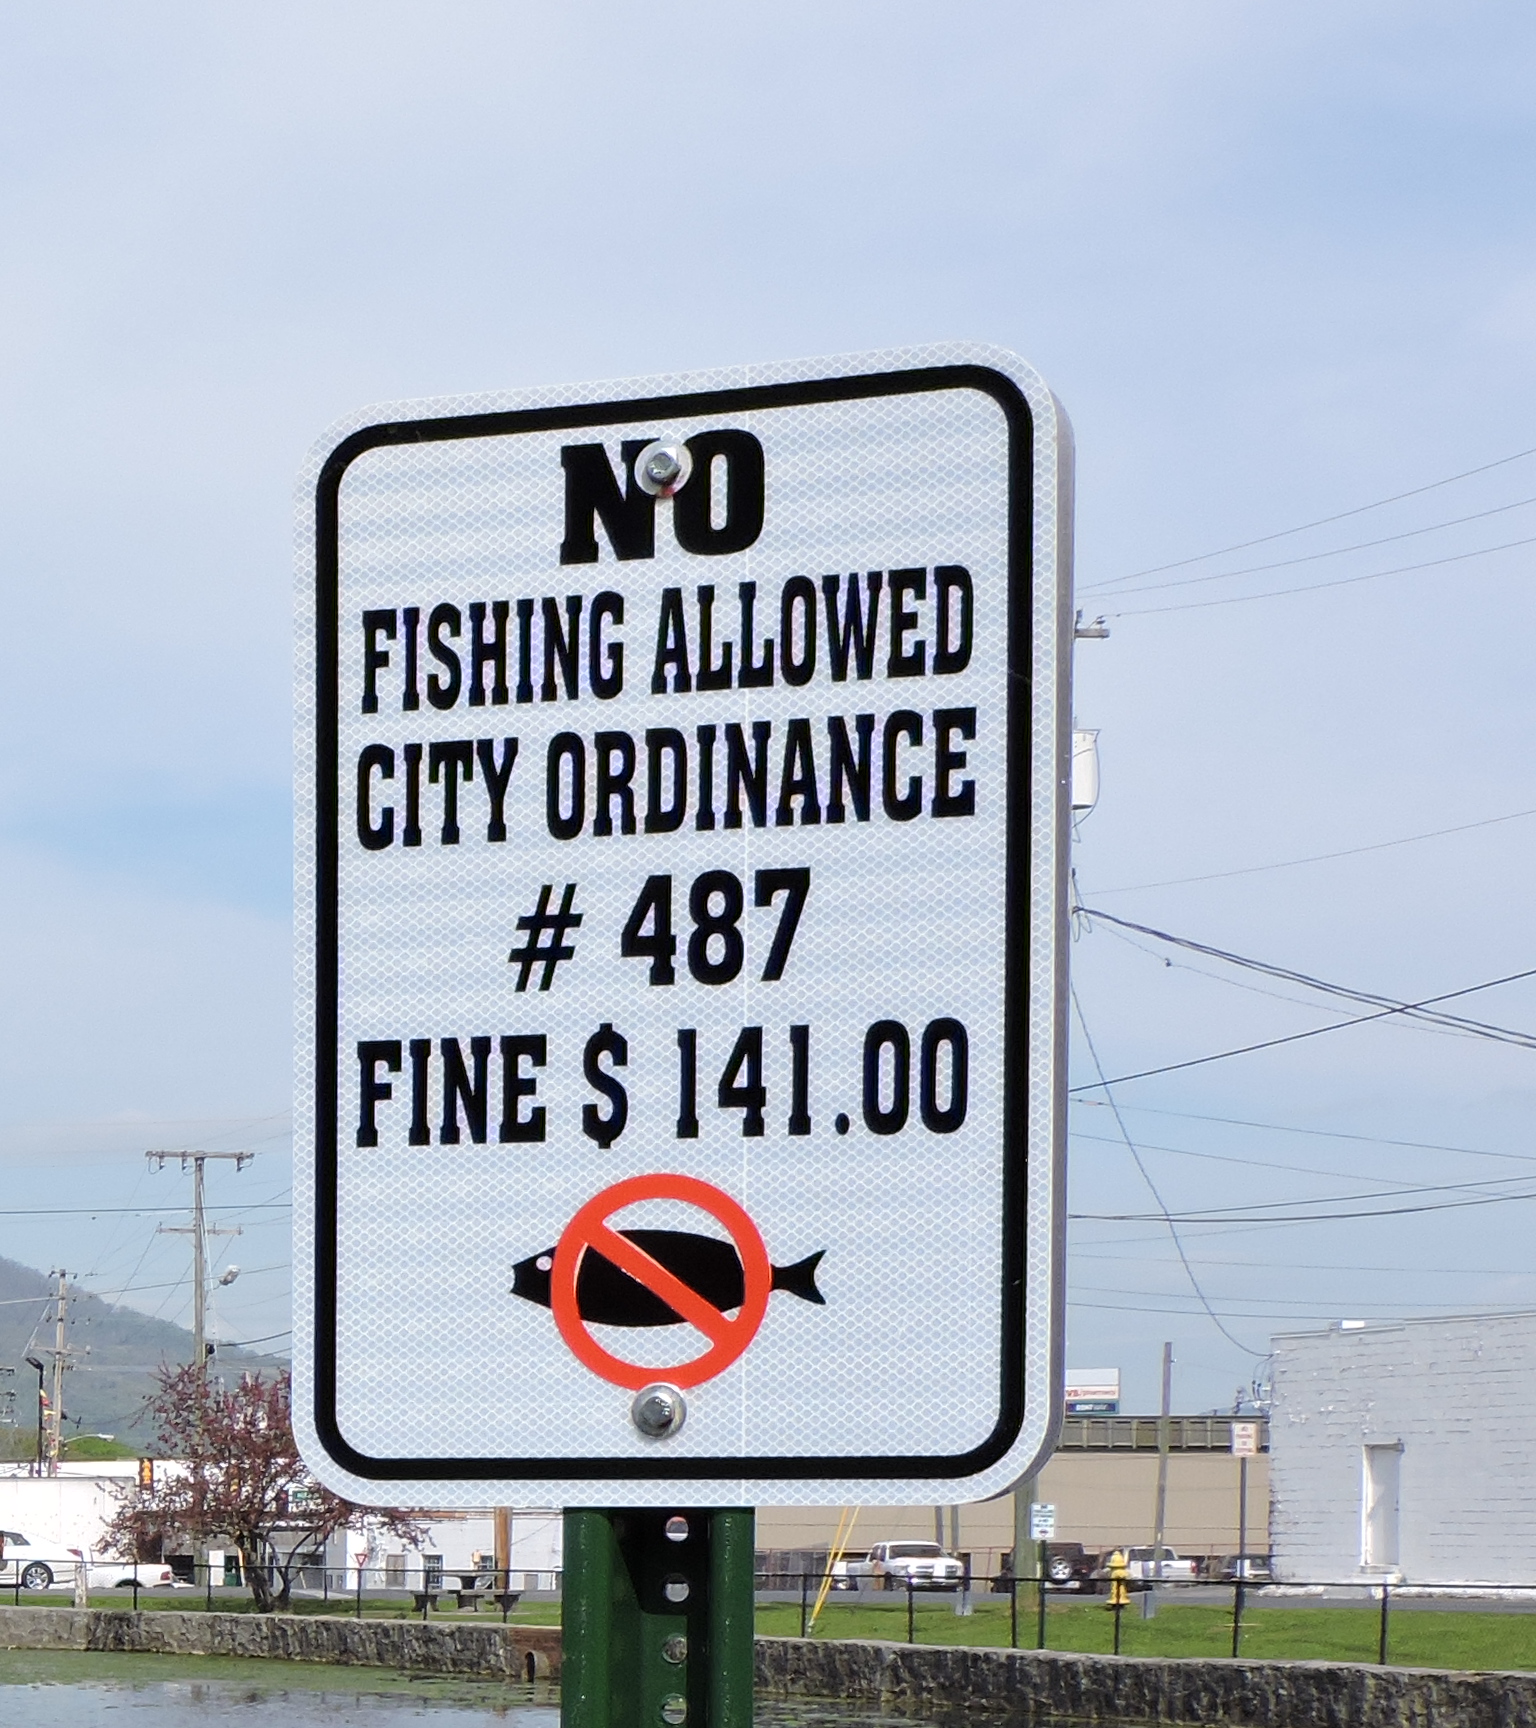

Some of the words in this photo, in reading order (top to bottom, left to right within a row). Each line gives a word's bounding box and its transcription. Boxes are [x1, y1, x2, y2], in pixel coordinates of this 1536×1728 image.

[560, 428, 765, 566] NO
[361, 590, 625, 714] FISHING
[651, 564, 974, 695] ALLOWED
[356, 736, 519, 851] CITY
[546, 706, 977, 841] ORDINANCE
[508, 883, 584, 993] #
[620, 866, 811, 986] 487
[356, 1033, 547, 1148] FINE
[582, 1022, 629, 1150] $
[676, 1017, 969, 1139] 141.00
